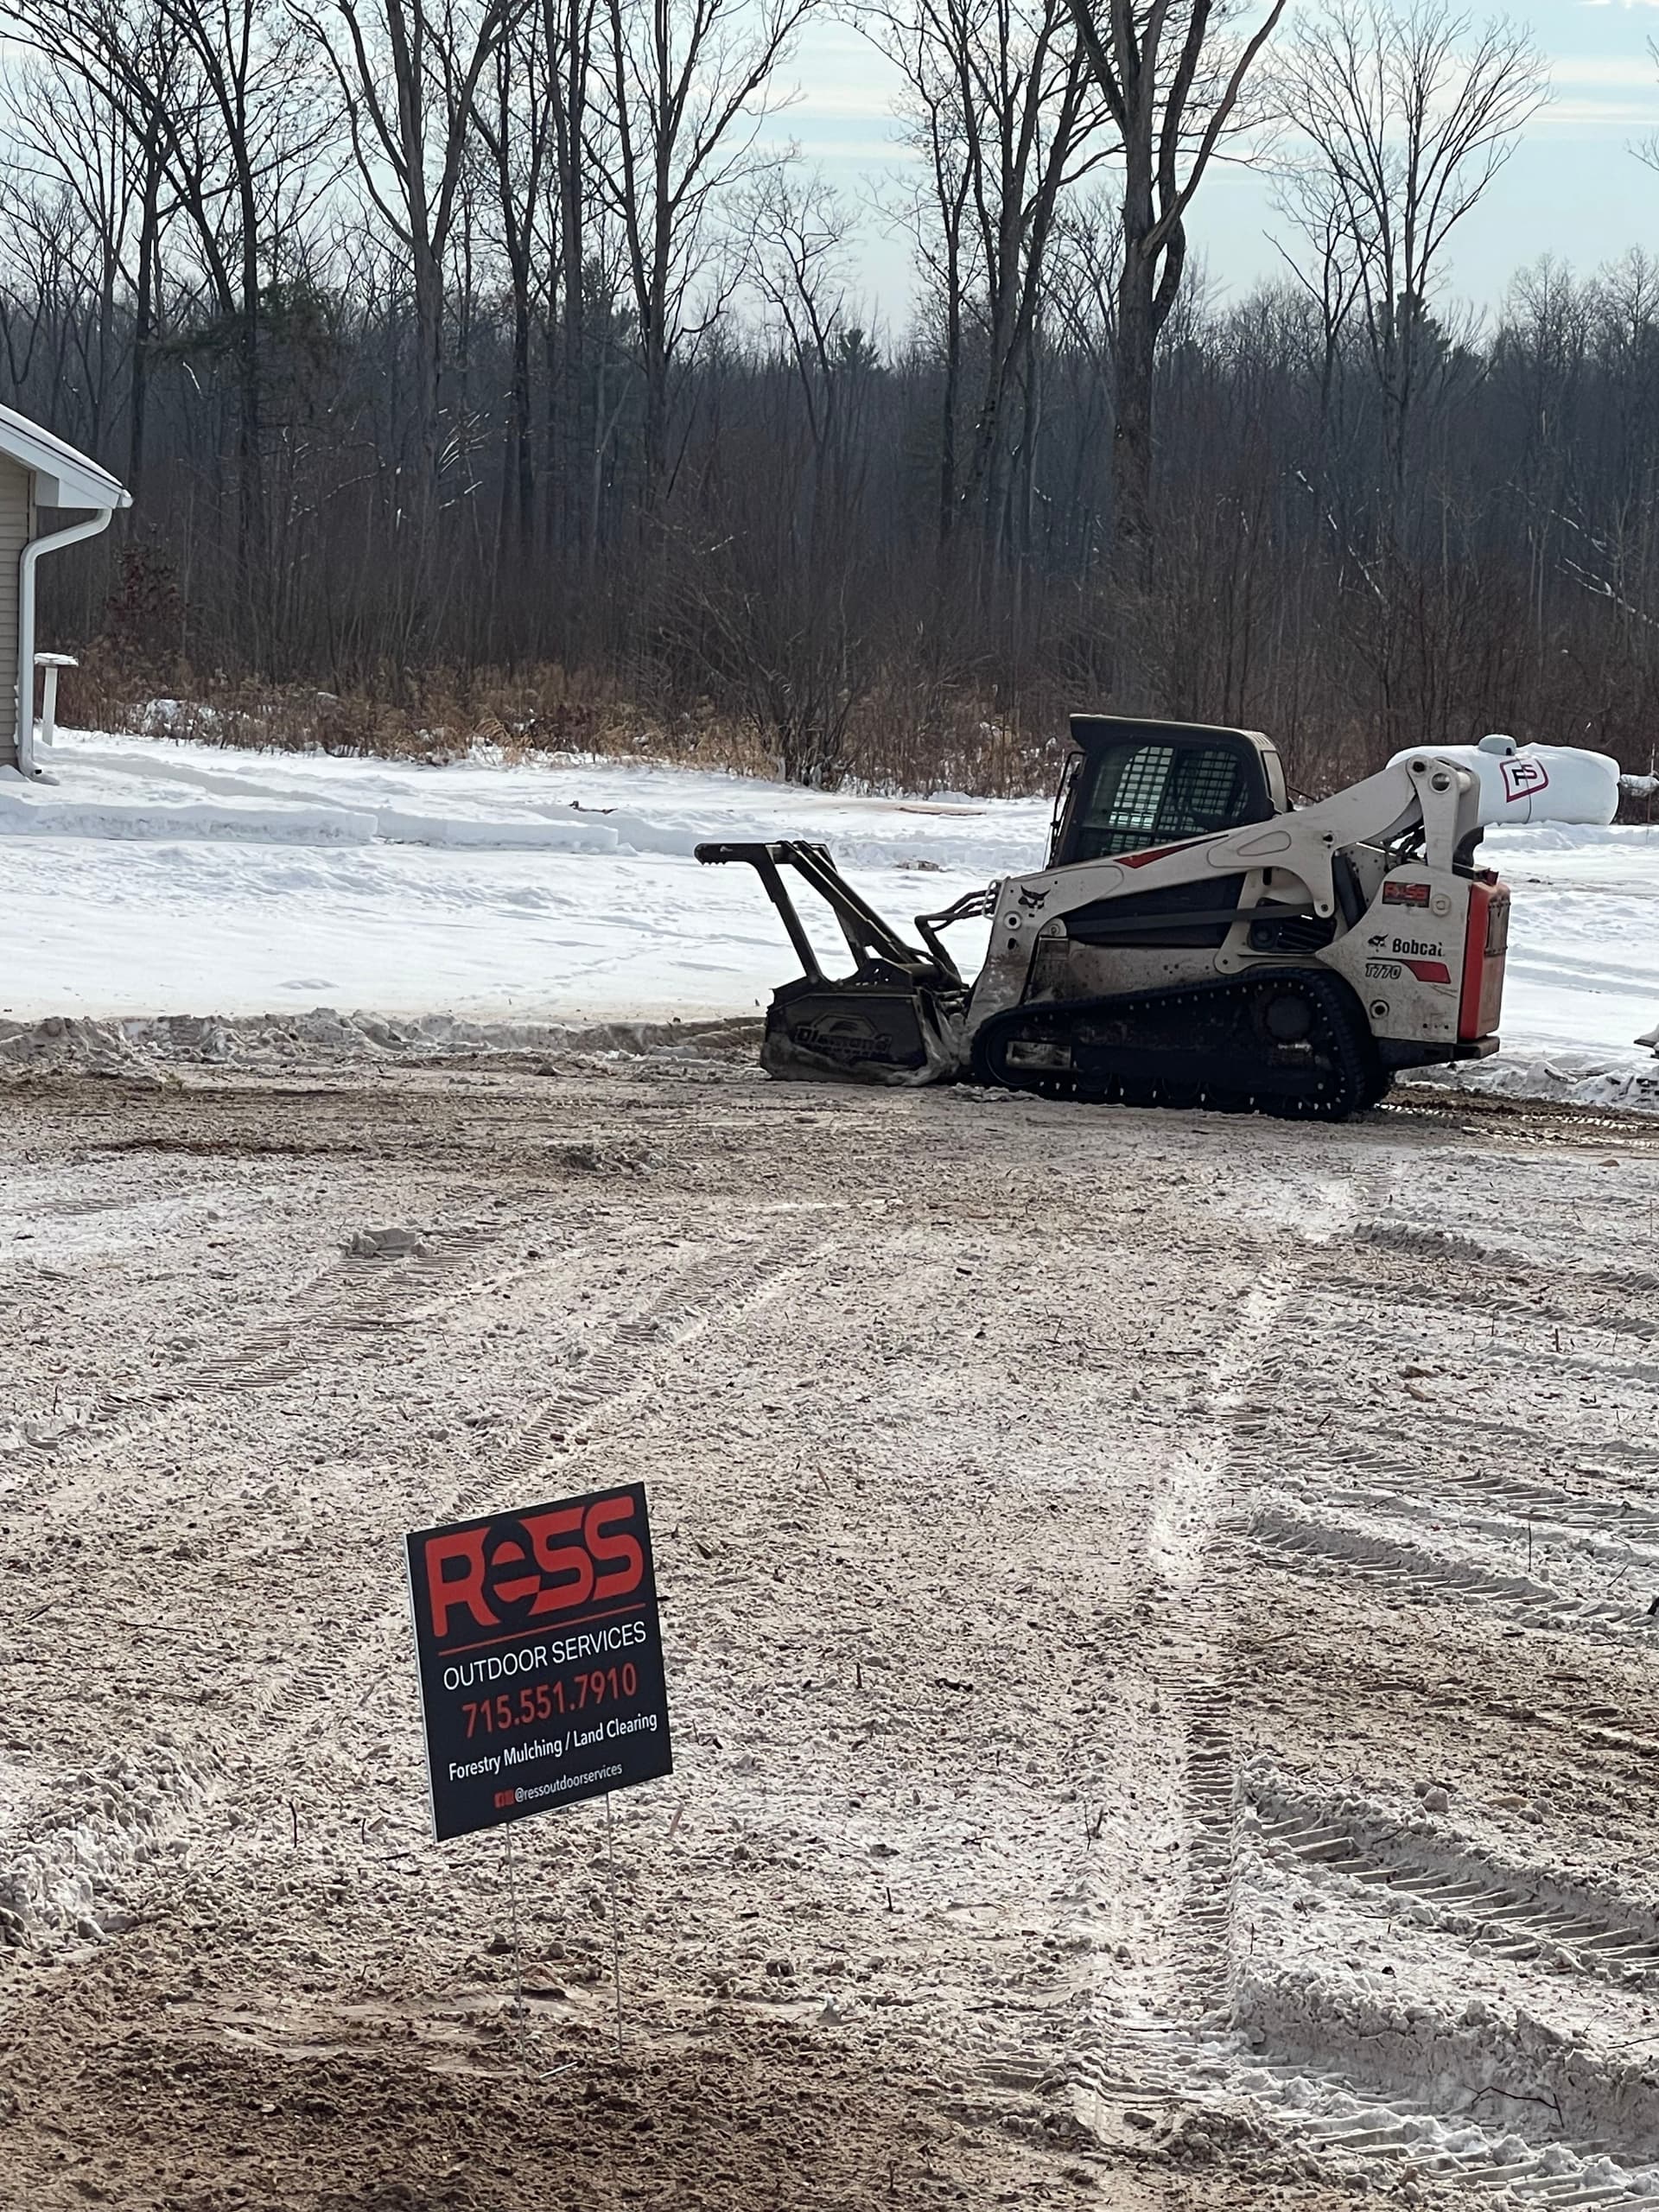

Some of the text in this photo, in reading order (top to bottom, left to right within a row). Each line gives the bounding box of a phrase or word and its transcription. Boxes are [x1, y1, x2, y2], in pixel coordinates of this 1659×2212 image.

[1365, 963, 1402, 979] T770
[443, 1621, 647, 1691] OUTDOOR SERVICES
[462, 1662, 638, 1738] 715.551.7910
[448, 1713, 658, 1782] Forestry Mulching / Land Clearing
[514, 1762, 623, 1803] @ressoutdoorservices
